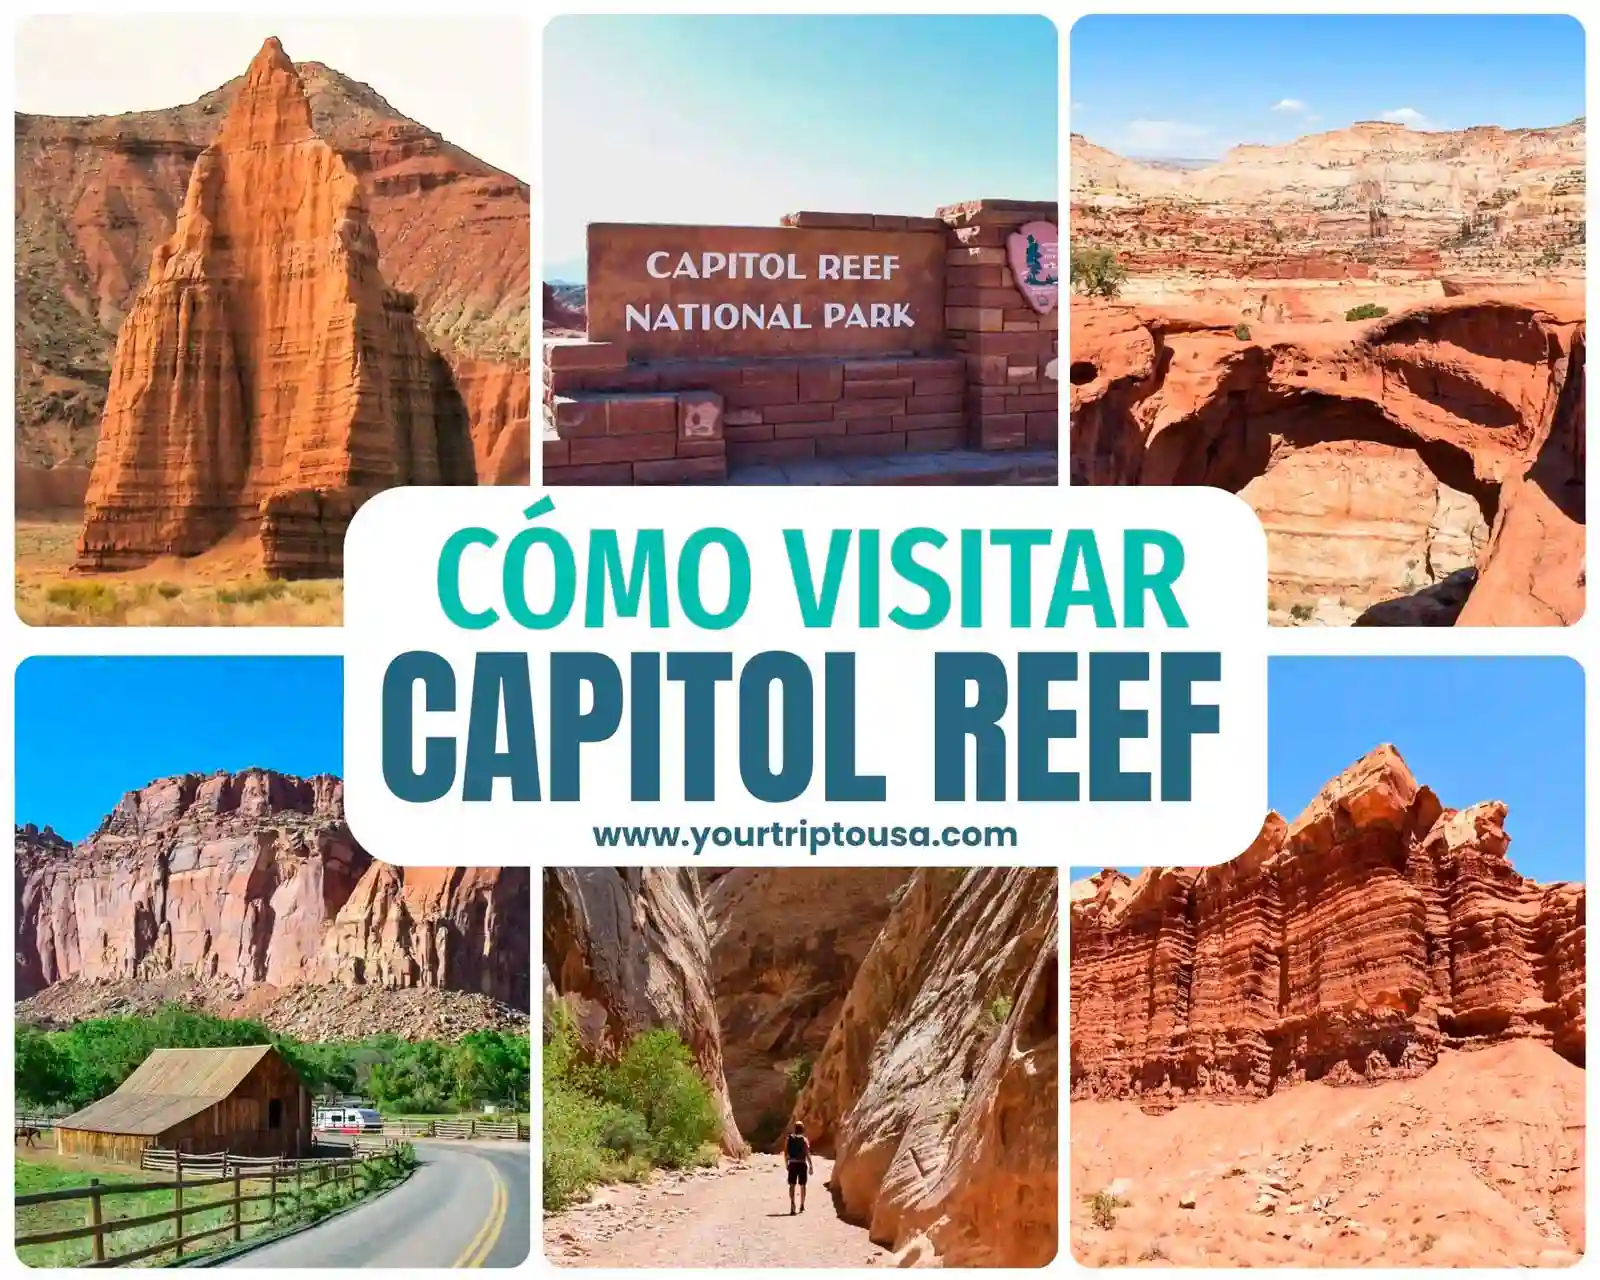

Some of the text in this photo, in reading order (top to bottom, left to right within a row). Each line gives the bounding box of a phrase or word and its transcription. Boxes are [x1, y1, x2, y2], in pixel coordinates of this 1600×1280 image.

[646, 251, 900, 281] CAPITOL REEF
[625, 303, 915, 332] NATIONAL PARK
